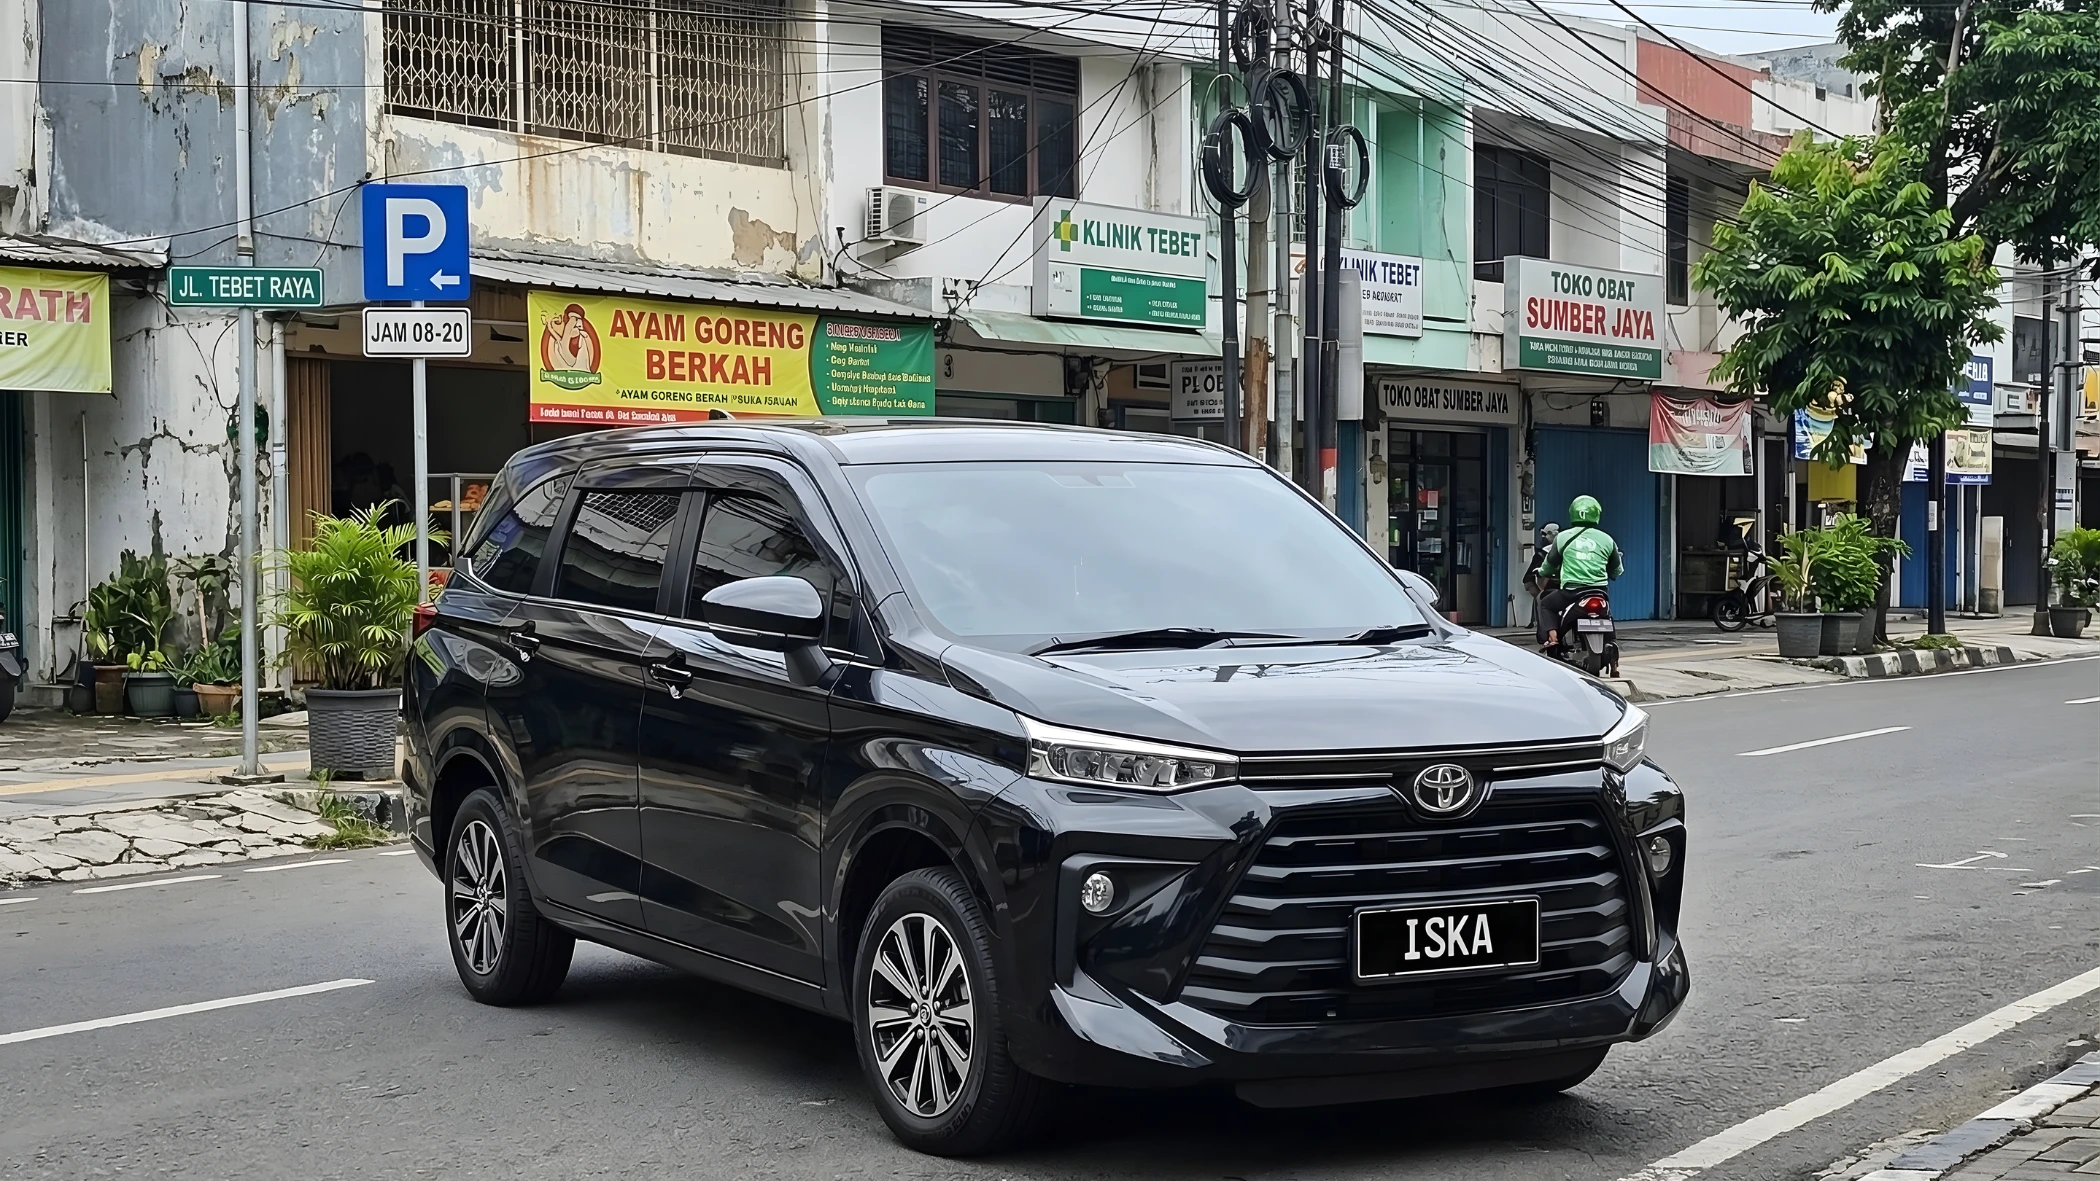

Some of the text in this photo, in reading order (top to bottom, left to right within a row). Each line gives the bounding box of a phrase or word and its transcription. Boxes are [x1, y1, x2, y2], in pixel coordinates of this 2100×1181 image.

[385, 197, 447, 287] P
[1083, 218, 1201, 258] KLINIK TEBET
[179, 275, 315, 299] JL. TEBET RAYA
[1381, 261, 1420, 287] TEBET
[1551, 270, 1635, 302] TOKO OBAT
[371, 322, 464, 343] JAM 08-20
[609, 309, 685, 341] AYAM
[695, 316, 805, 349] GORENG
[1527, 296, 1655, 341] SUMBER JAYA
[646, 349, 771, 386] BERKAH
[651, 391, 693, 402] GORENG
[695, 393, 728, 403] BERAH
[1384, 384, 1509, 414] TOKO OBAT SUMBER JAYA
[1404, 913, 1494, 961] ISKA
